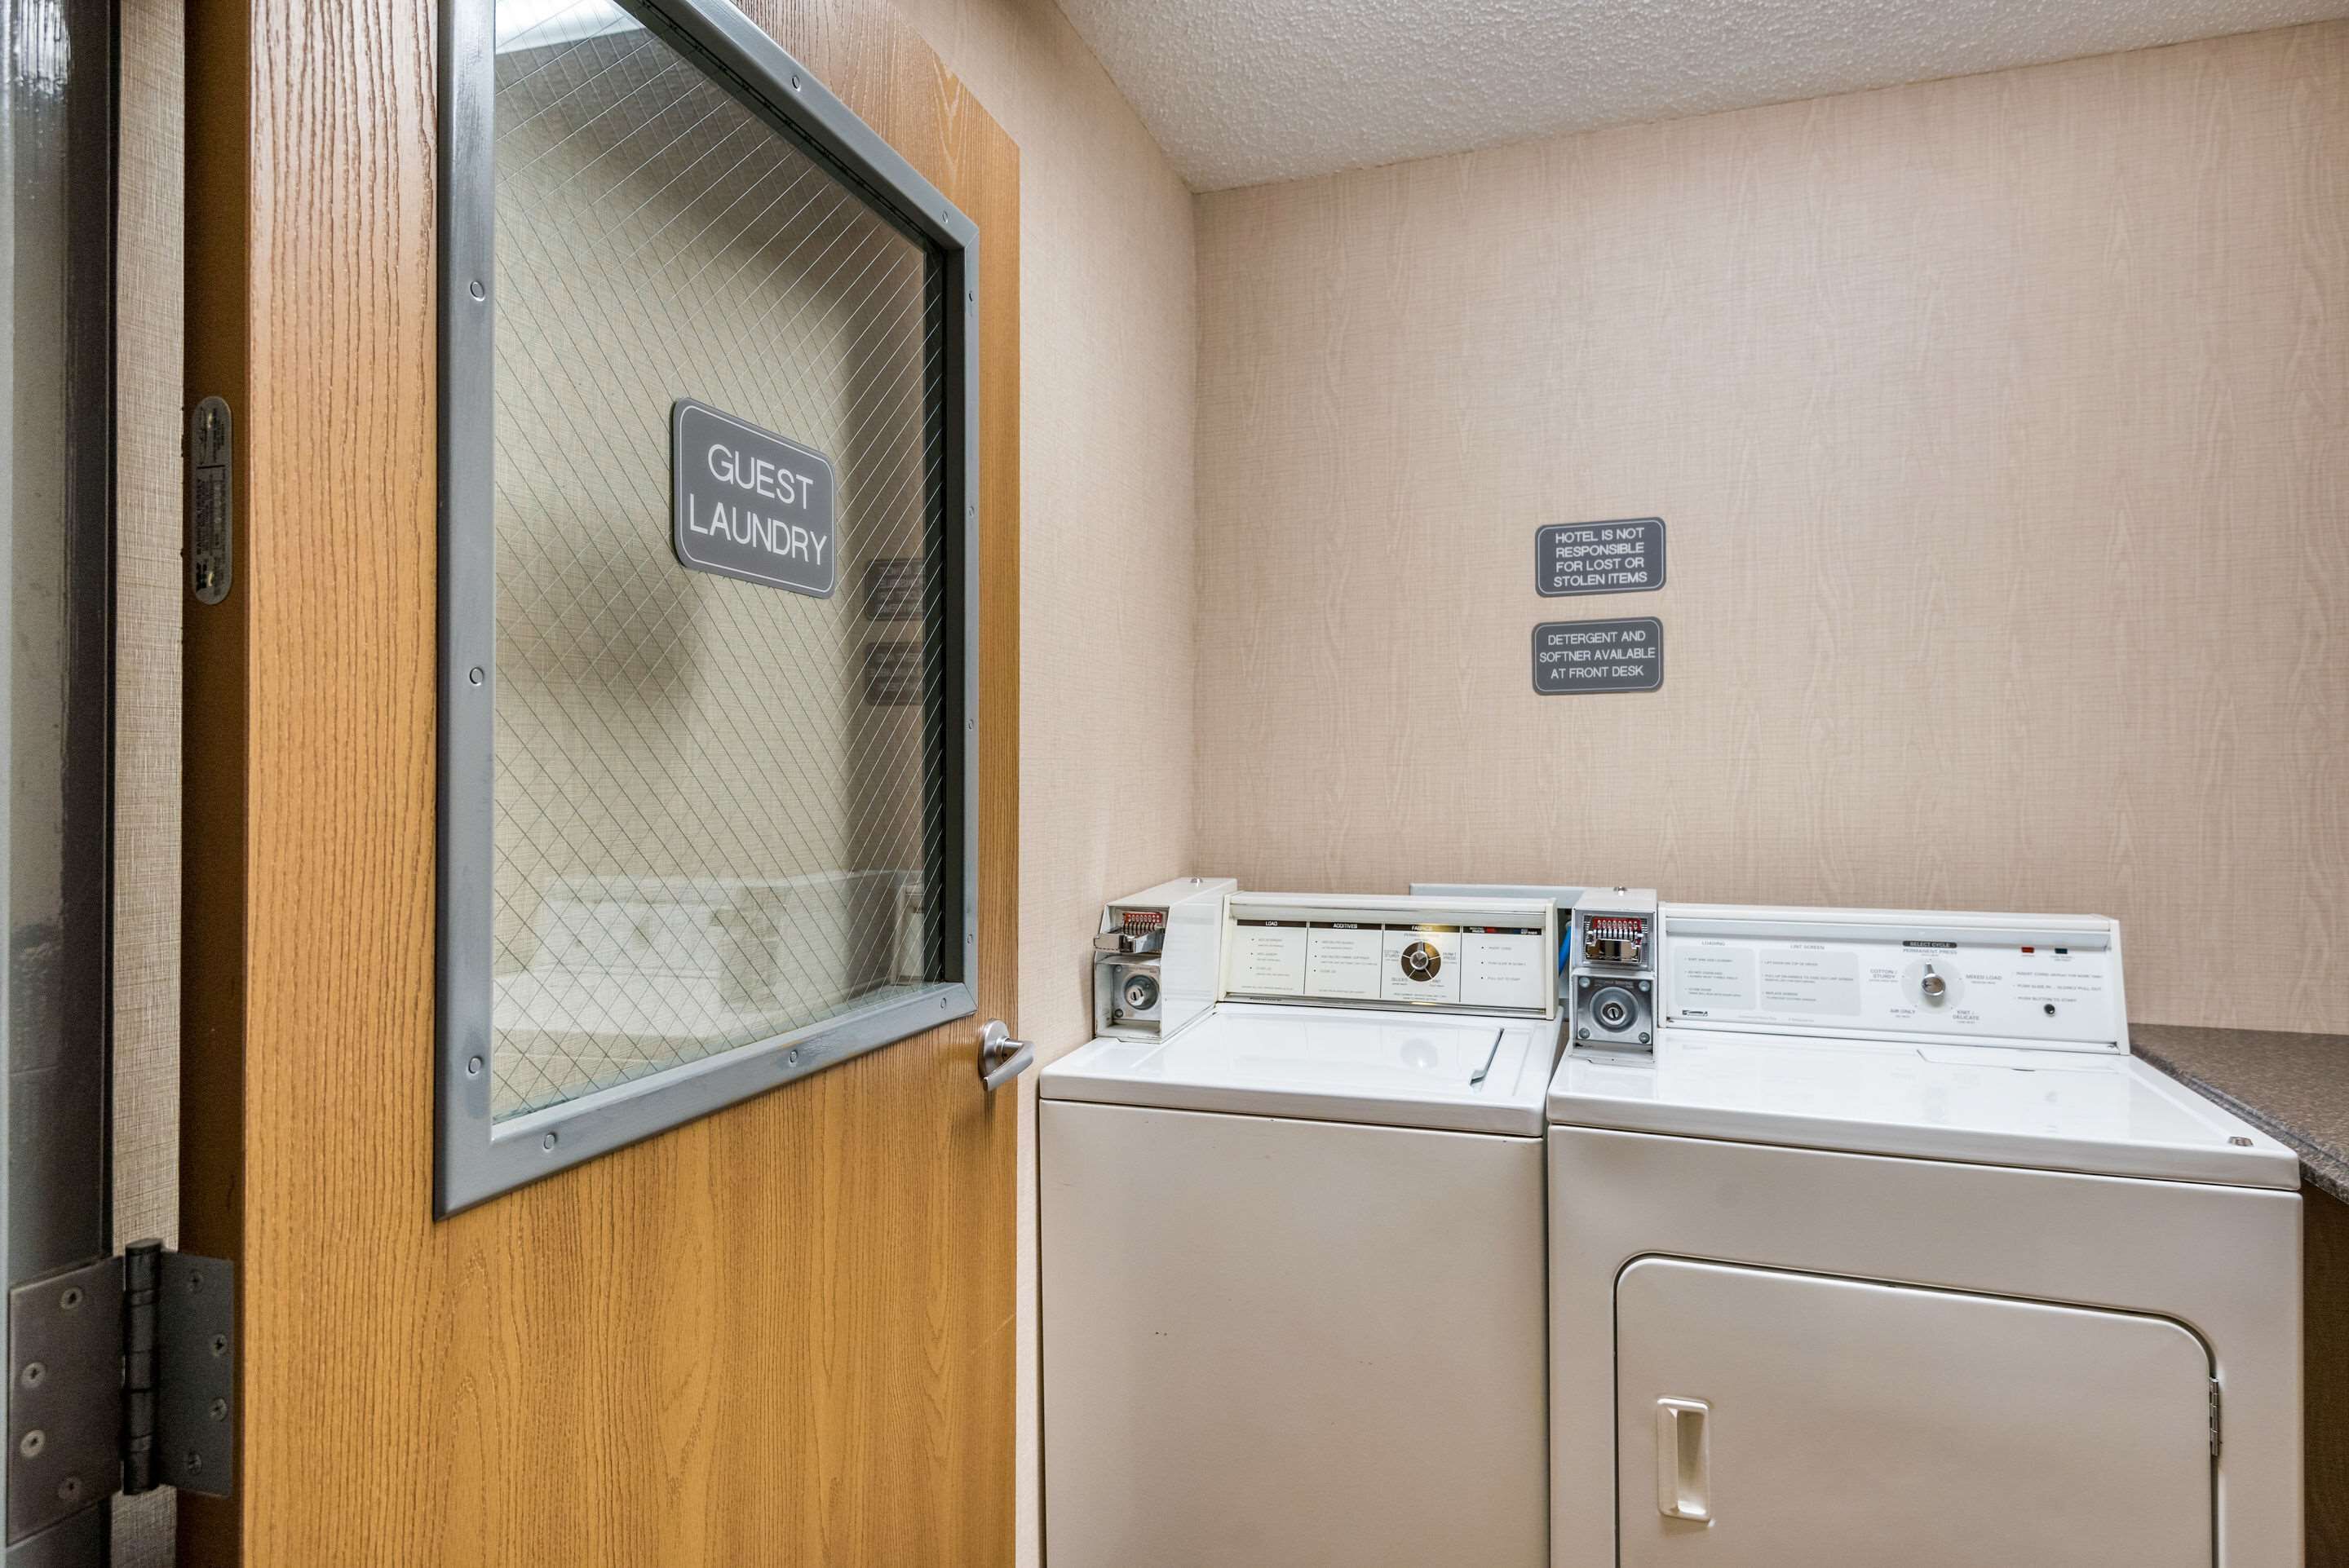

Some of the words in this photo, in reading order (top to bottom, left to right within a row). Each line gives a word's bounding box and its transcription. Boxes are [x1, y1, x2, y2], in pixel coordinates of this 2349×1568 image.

[708, 444, 814, 510] GUEST
[689, 493, 827, 565] LAUNDRY
[1555, 531, 1598, 544] HOTEL
[1601, 529, 1613, 541] IS
[1617, 528, 1645, 540] NOT
[1555, 542, 1644, 558] RESPONSIBLE
[1555, 560, 1583, 572] FOR
[1586, 559, 1621, 571] LOST
[1625, 557, 1644, 568] OR
[1553, 574, 1605, 587] STOLEN
[1608, 572, 1648, 585] ITEMS
[1548, 632, 1618, 646] DETERGENT
[1621, 630, 1646, 642] AND
[1539, 650, 1591, 663] SOFTNER
[1594, 647, 1656, 660] AVAILABLE
[1551, 668, 1566, 679] AT
[1569, 666, 1609, 678] FRONT
[1612, 665, 1644, 677] DESK
